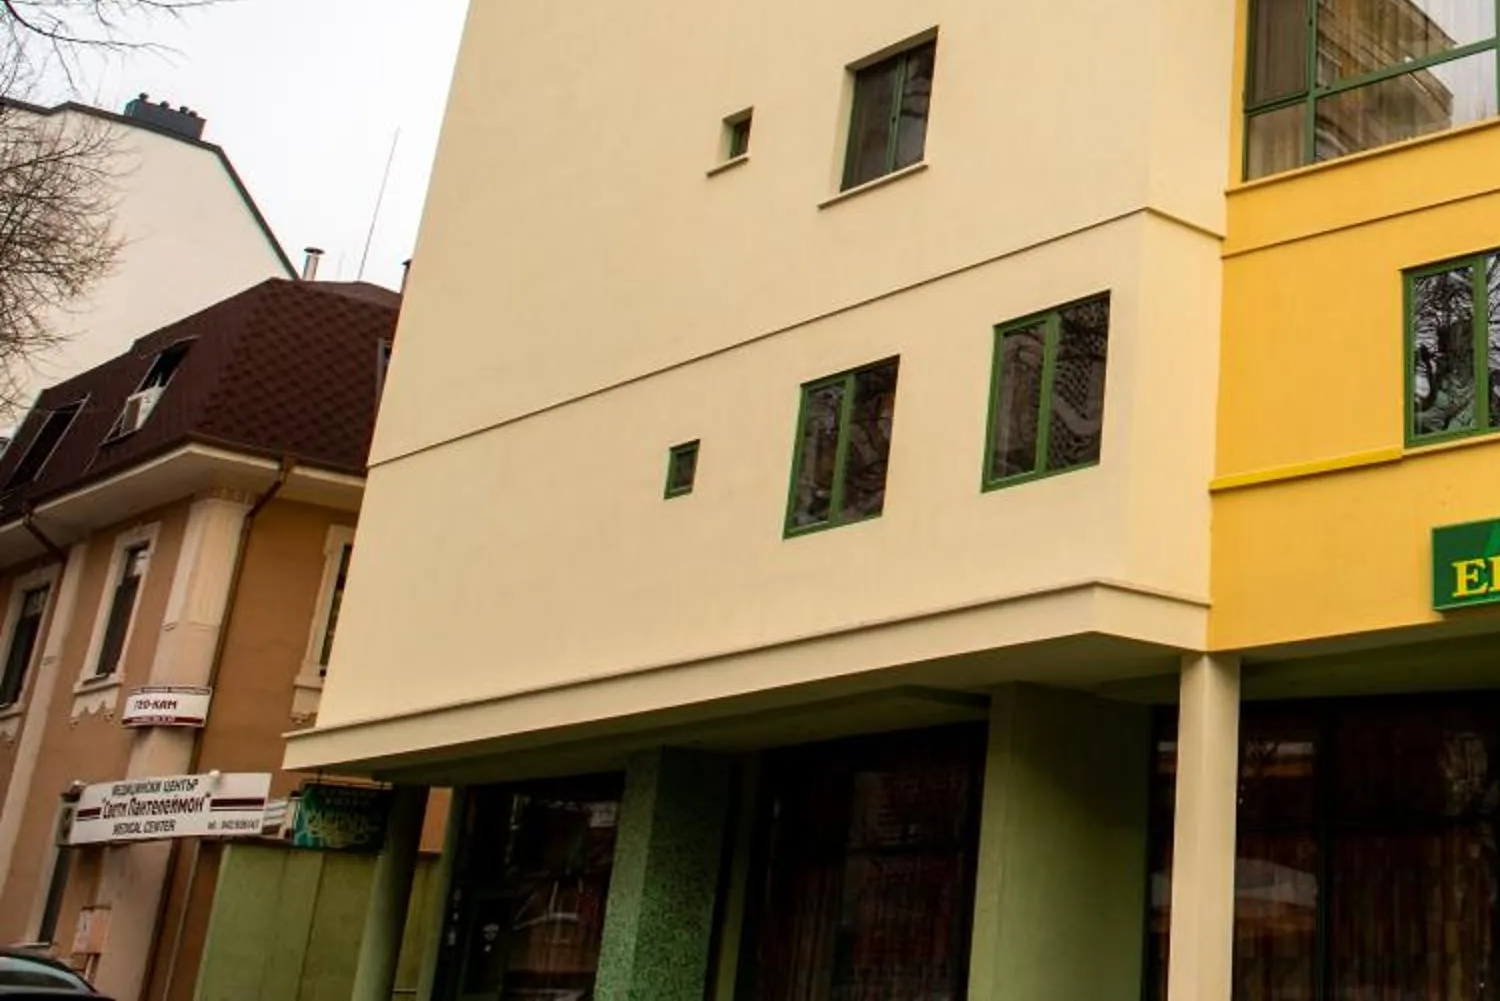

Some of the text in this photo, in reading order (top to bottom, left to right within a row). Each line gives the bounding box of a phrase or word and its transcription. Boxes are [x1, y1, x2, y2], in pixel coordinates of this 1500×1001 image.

[163, 778, 199, 792] ЦЕНТЪР
[112, 819, 177, 836] MEDICAL CENTER
